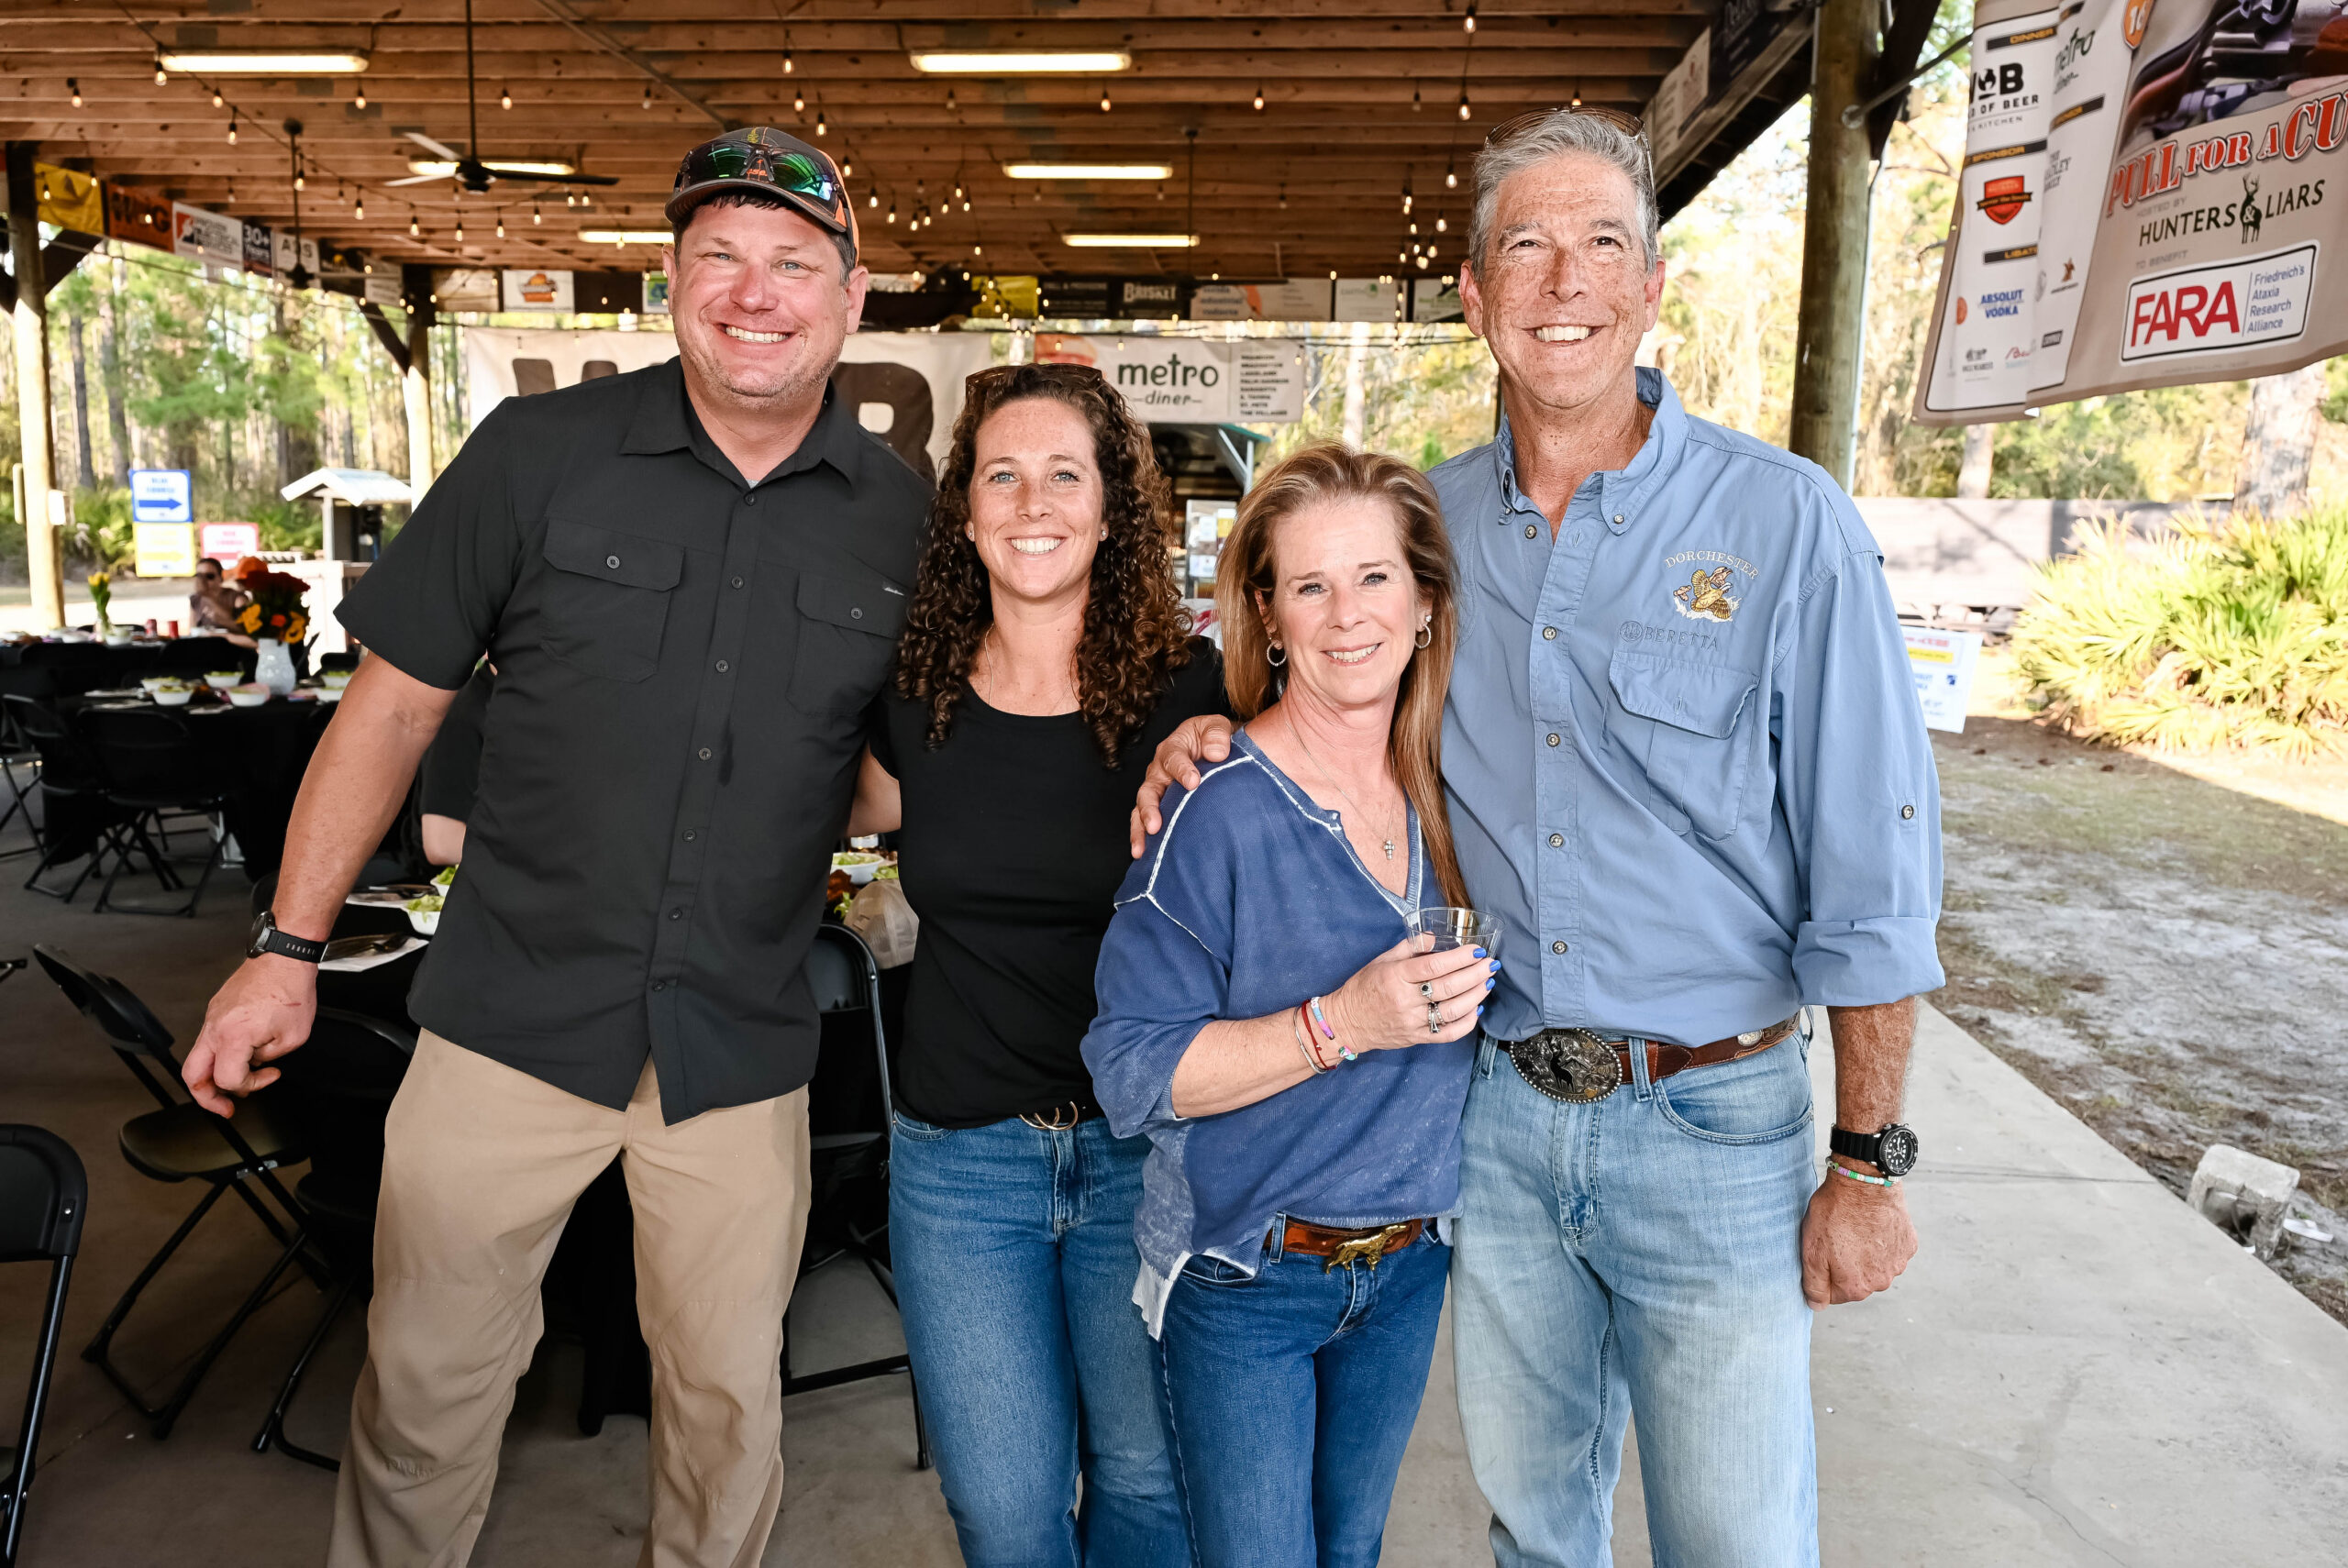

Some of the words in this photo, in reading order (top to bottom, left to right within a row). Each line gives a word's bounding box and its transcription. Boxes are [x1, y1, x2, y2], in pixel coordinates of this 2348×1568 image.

[2010, 28, 2054, 44] DINNER
[1980, 103, 1995, 115] OF
[2003, 94, 2040, 109] BEER
[1978, 116, 2023, 129] KITCHEN
[2107, 140, 2181, 217] PULL
[2185, 132, 2252, 177] FOR
[2136, 199, 2170, 217] HOSTED
[2173, 196, 2187, 207] BY
[2139, 204, 2237, 247] HUNTERS
[2244, 205, 2255, 221] &
[2265, 179, 2326, 219] LIARS
[2149, 249, 2189, 268] BENEFIT
[2254, 265, 2305, 285] Friedreich's
[1981, 289, 2024, 304] ABSOLUT
[2252, 286, 2280, 302] Ataxia
[1985, 305, 2019, 318] VODKA
[2131, 281, 2241, 348] FARA
[2250, 299, 2292, 317] Research
[2247, 317, 2284, 334] Alliance
[1118, 353, 1219, 387] metro
[1146, 391, 1192, 405] diner
[1665, 550, 1760, 580] DORCHESTER
[1644, 625, 1718, 651] BERETTA
